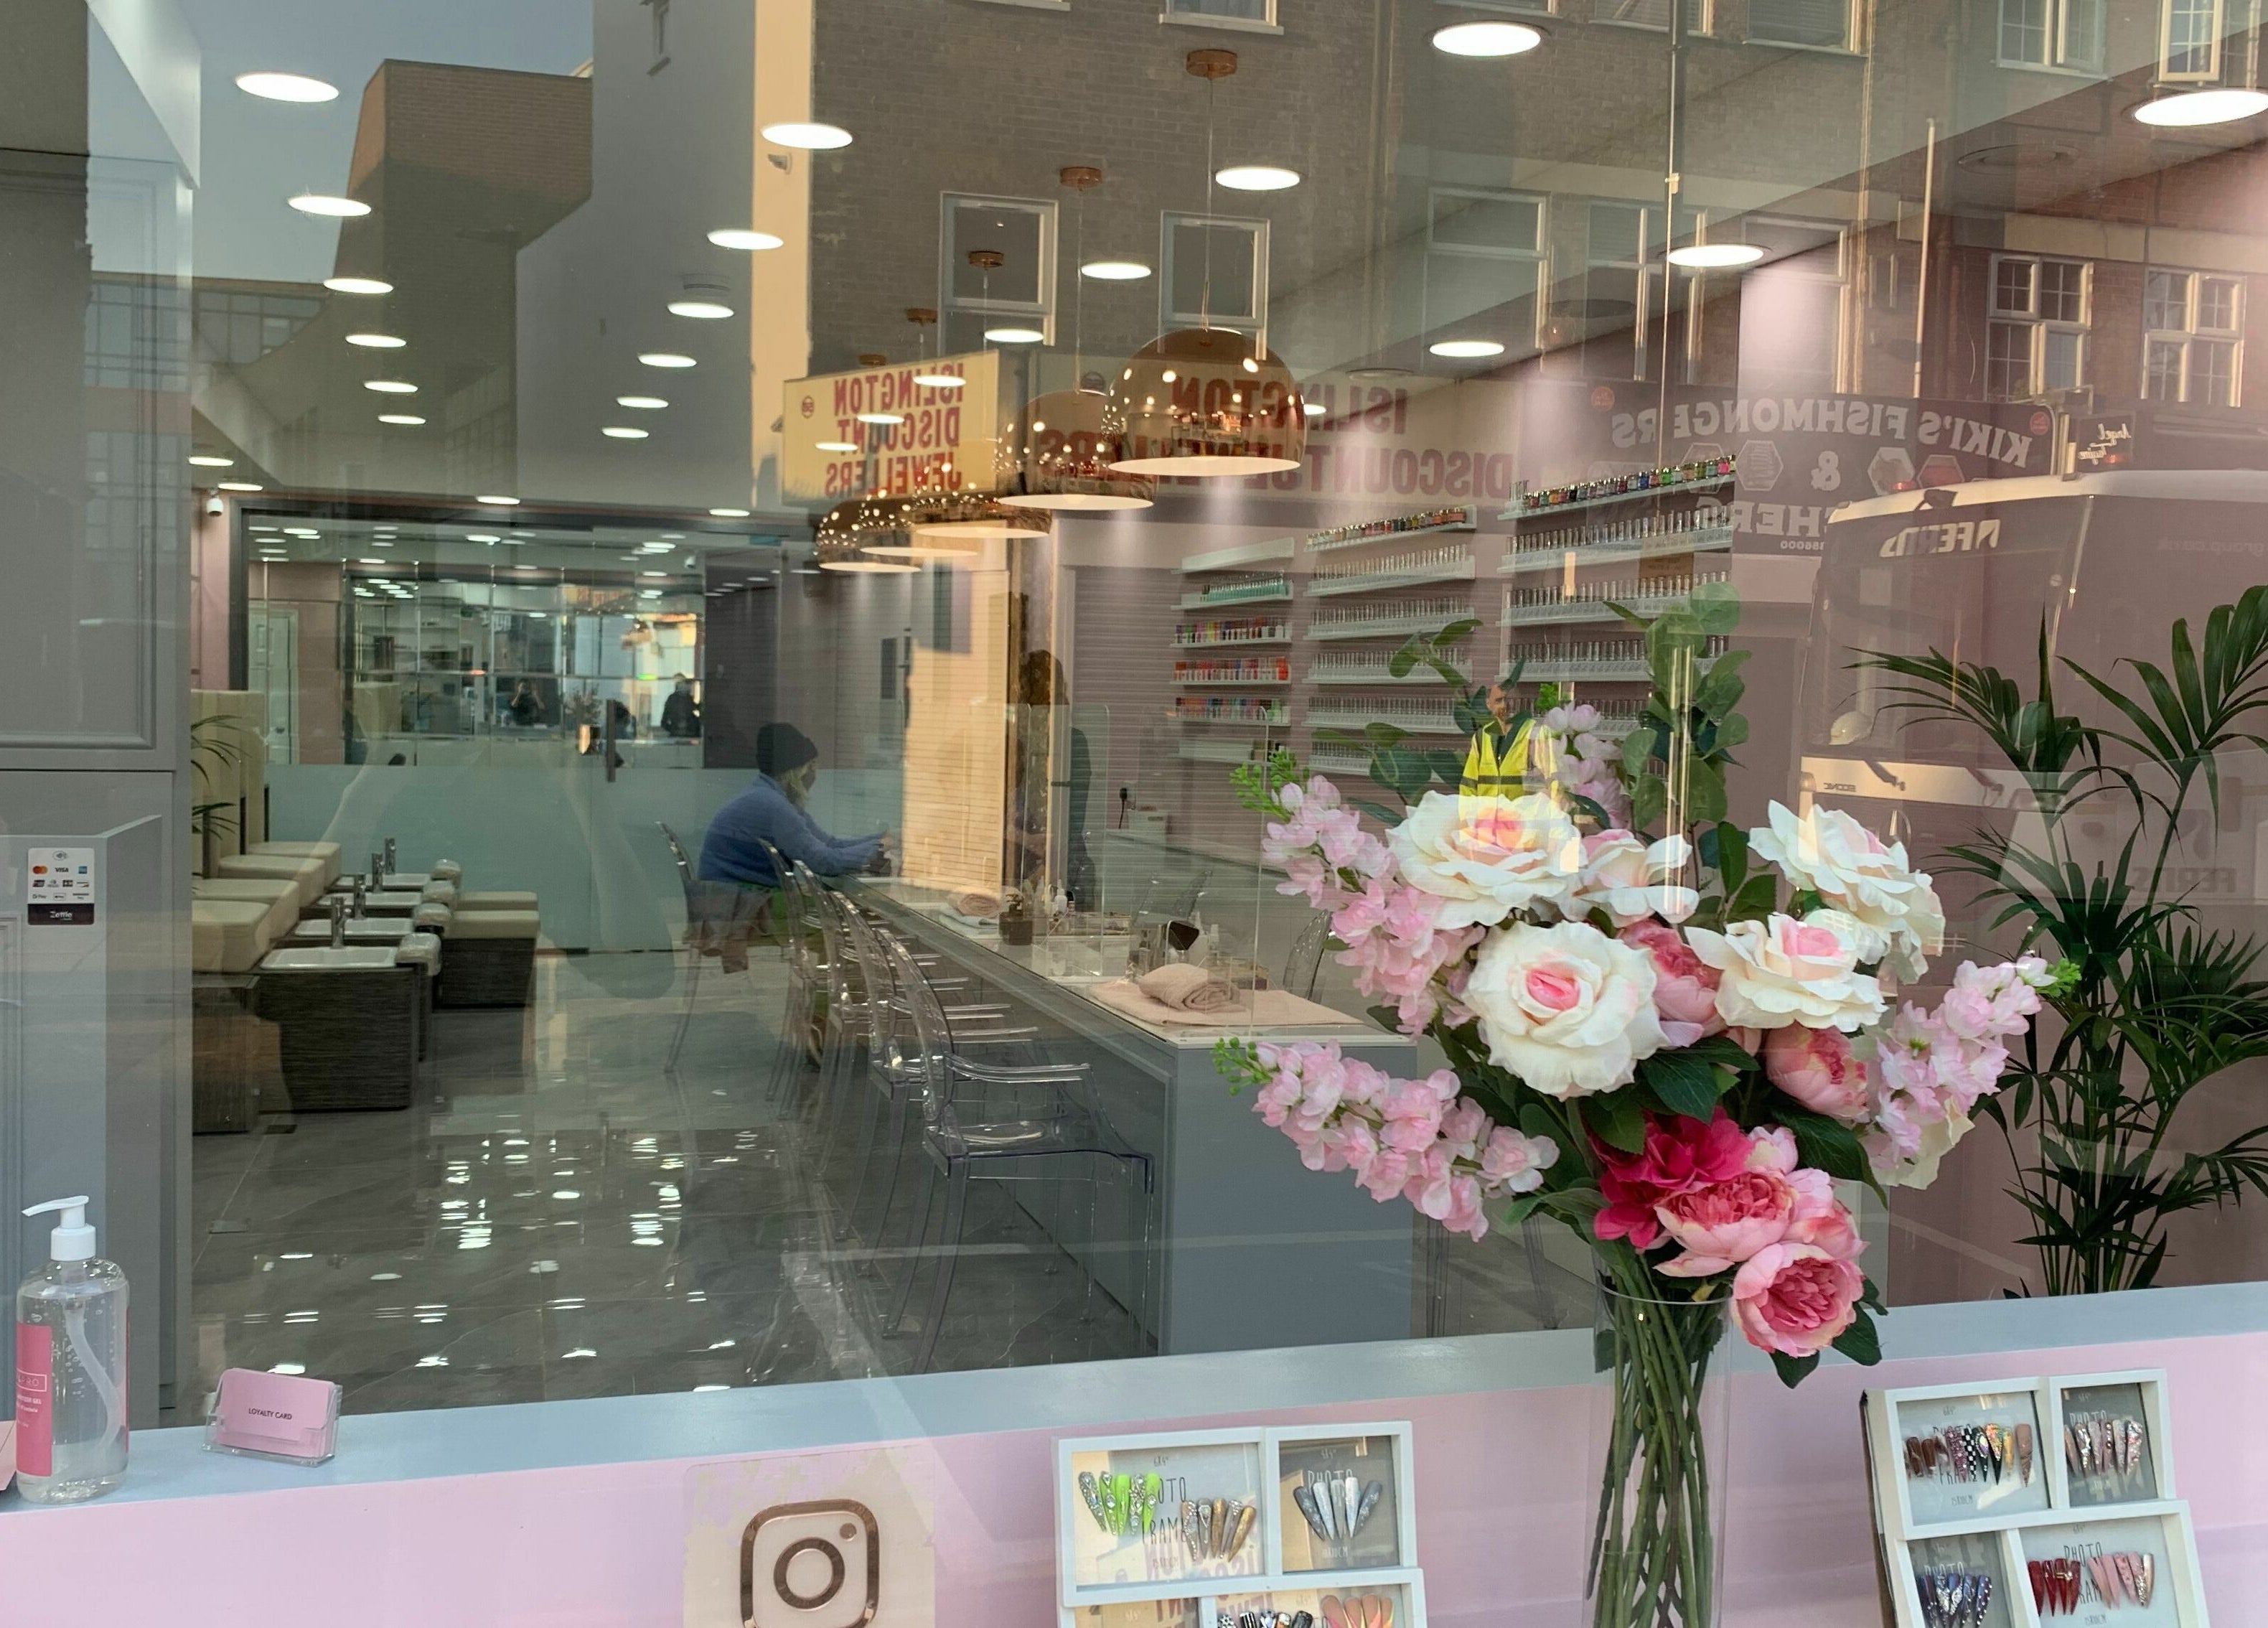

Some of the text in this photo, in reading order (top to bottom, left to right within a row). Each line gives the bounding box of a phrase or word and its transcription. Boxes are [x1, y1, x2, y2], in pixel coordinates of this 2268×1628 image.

[248, 1407, 293, 1420] LOYALTY CARD
[1158, 1477, 1187, 1505] OTO
[2063, 1541, 2103, 1568] PHOTO
